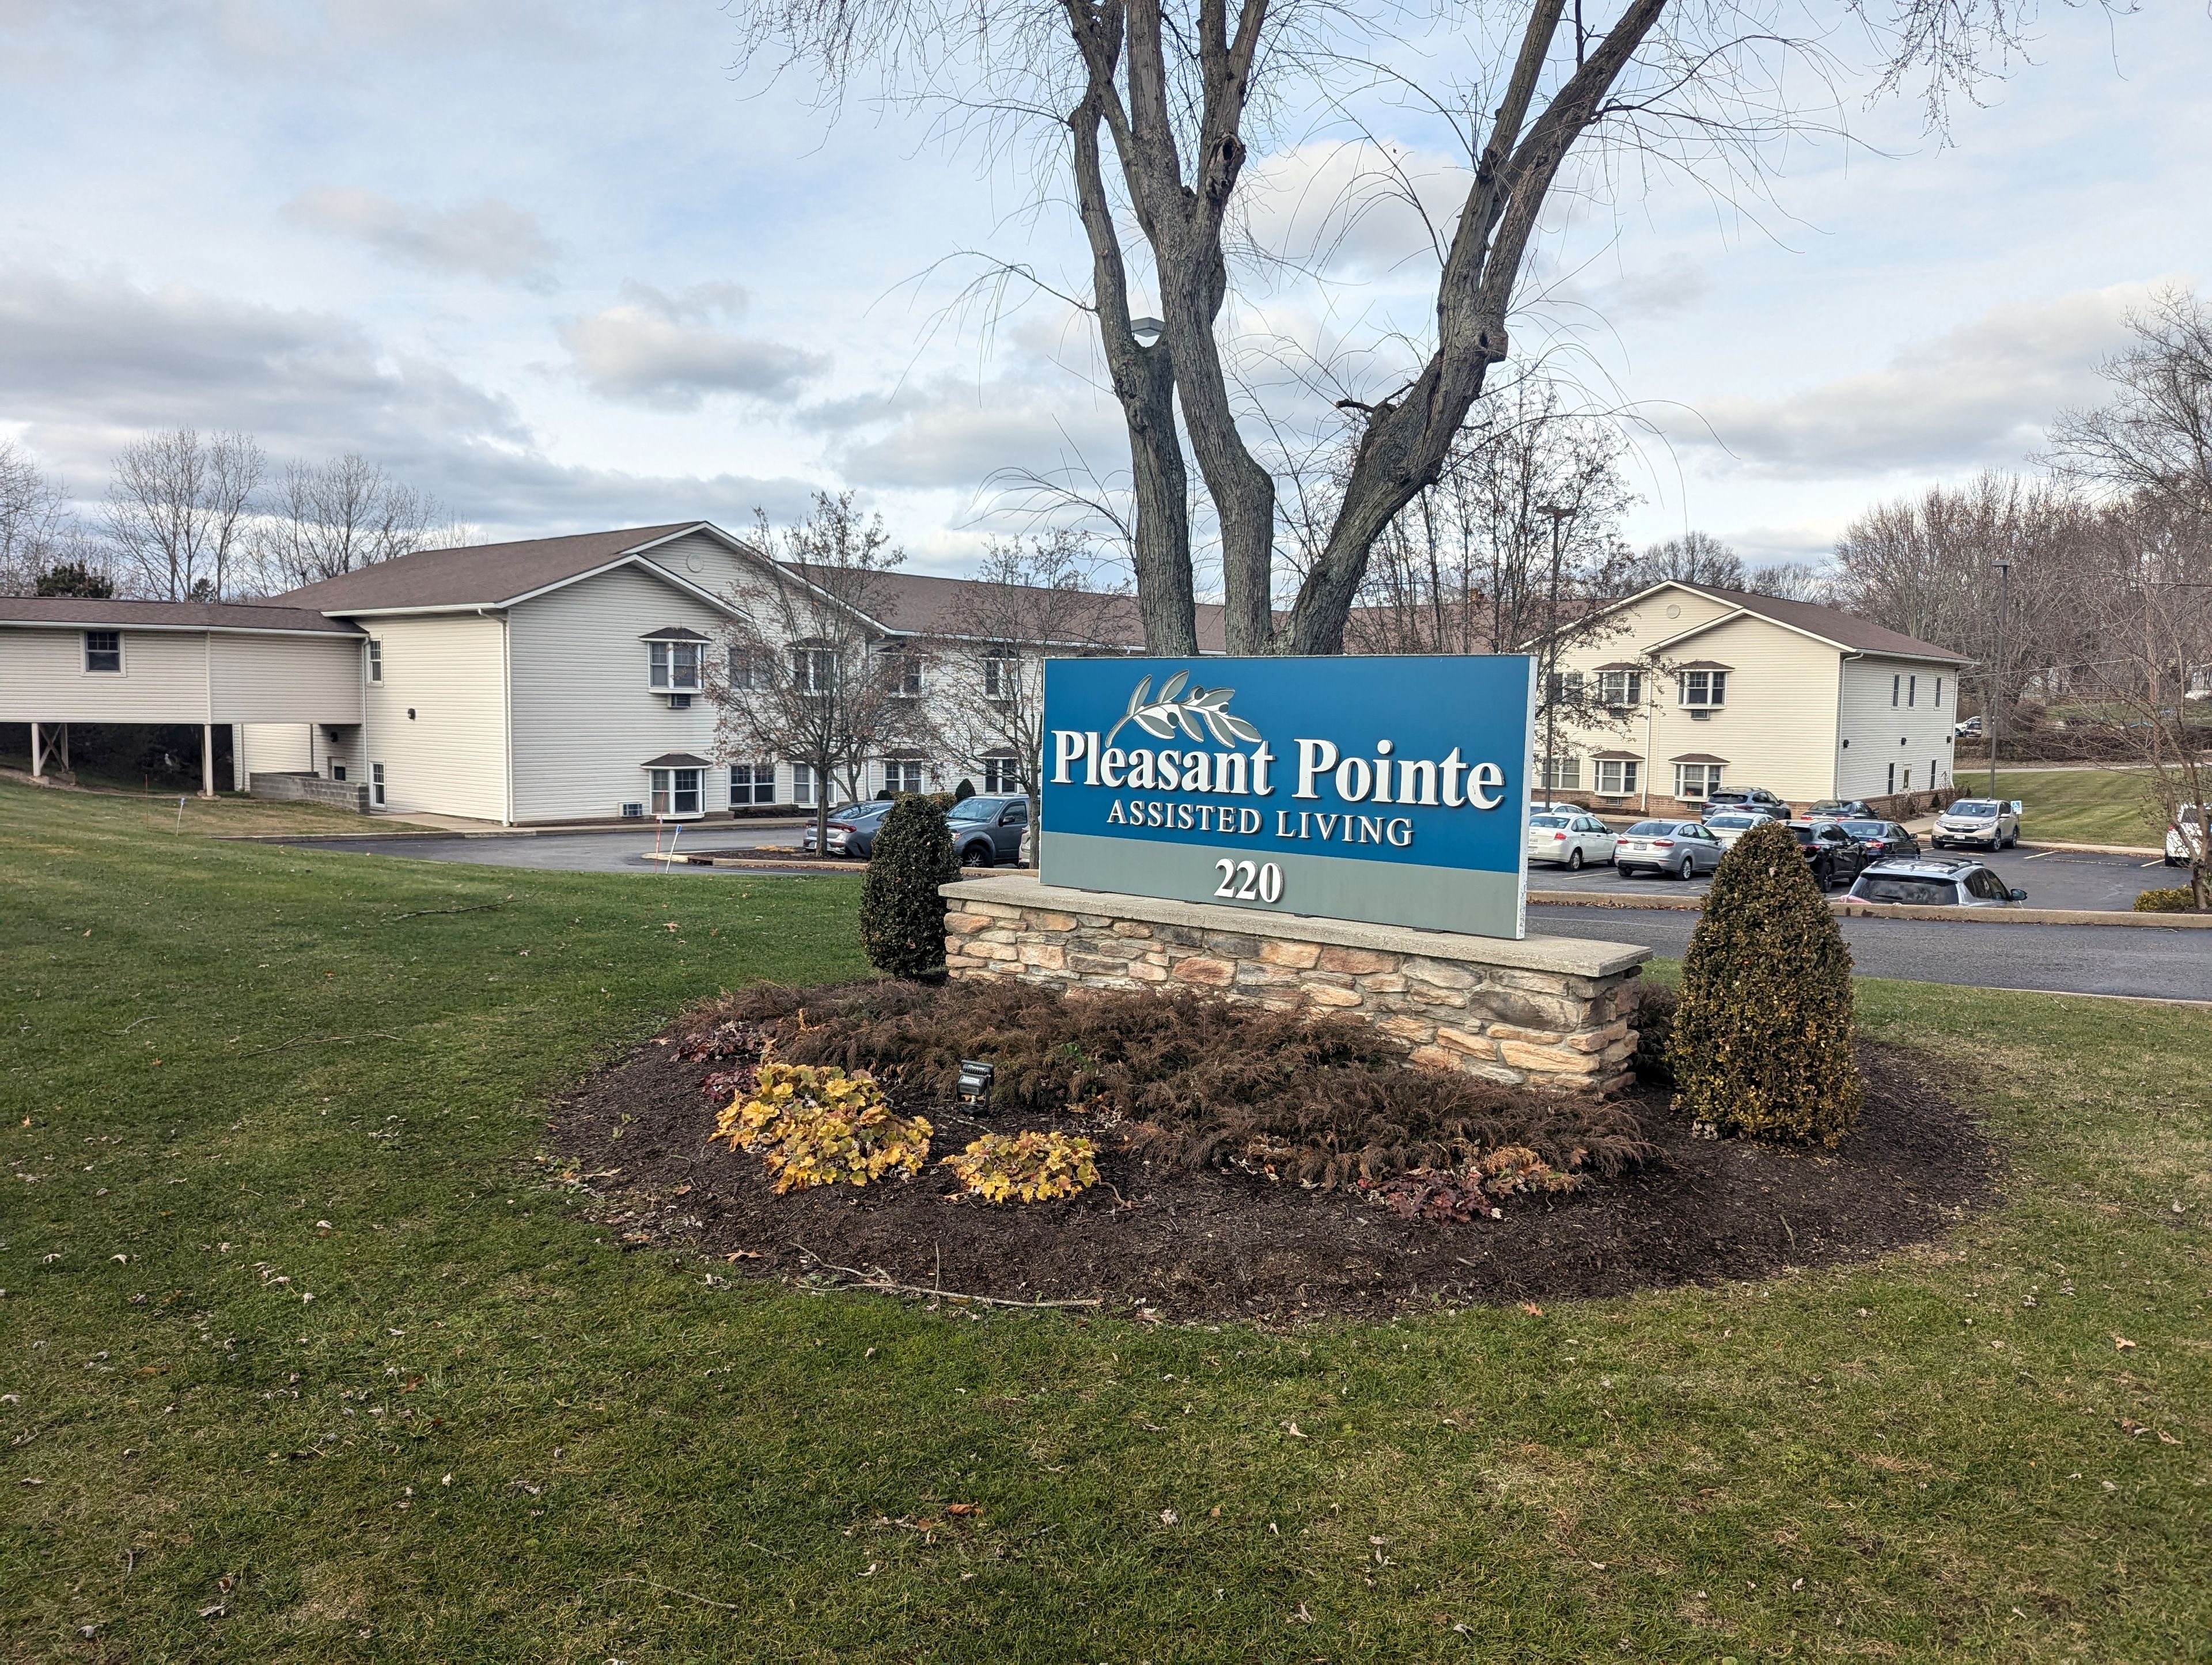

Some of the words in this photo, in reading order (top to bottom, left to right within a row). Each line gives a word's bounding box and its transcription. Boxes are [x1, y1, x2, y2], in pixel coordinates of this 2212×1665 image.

[1050, 730, 1277, 796] Pleasant
[1291, 738, 1505, 810] Pointe
[1106, 799, 1263, 835] ASSISTED
[1275, 810, 1415, 847] LIVING
[1213, 858, 1284, 903] 220
